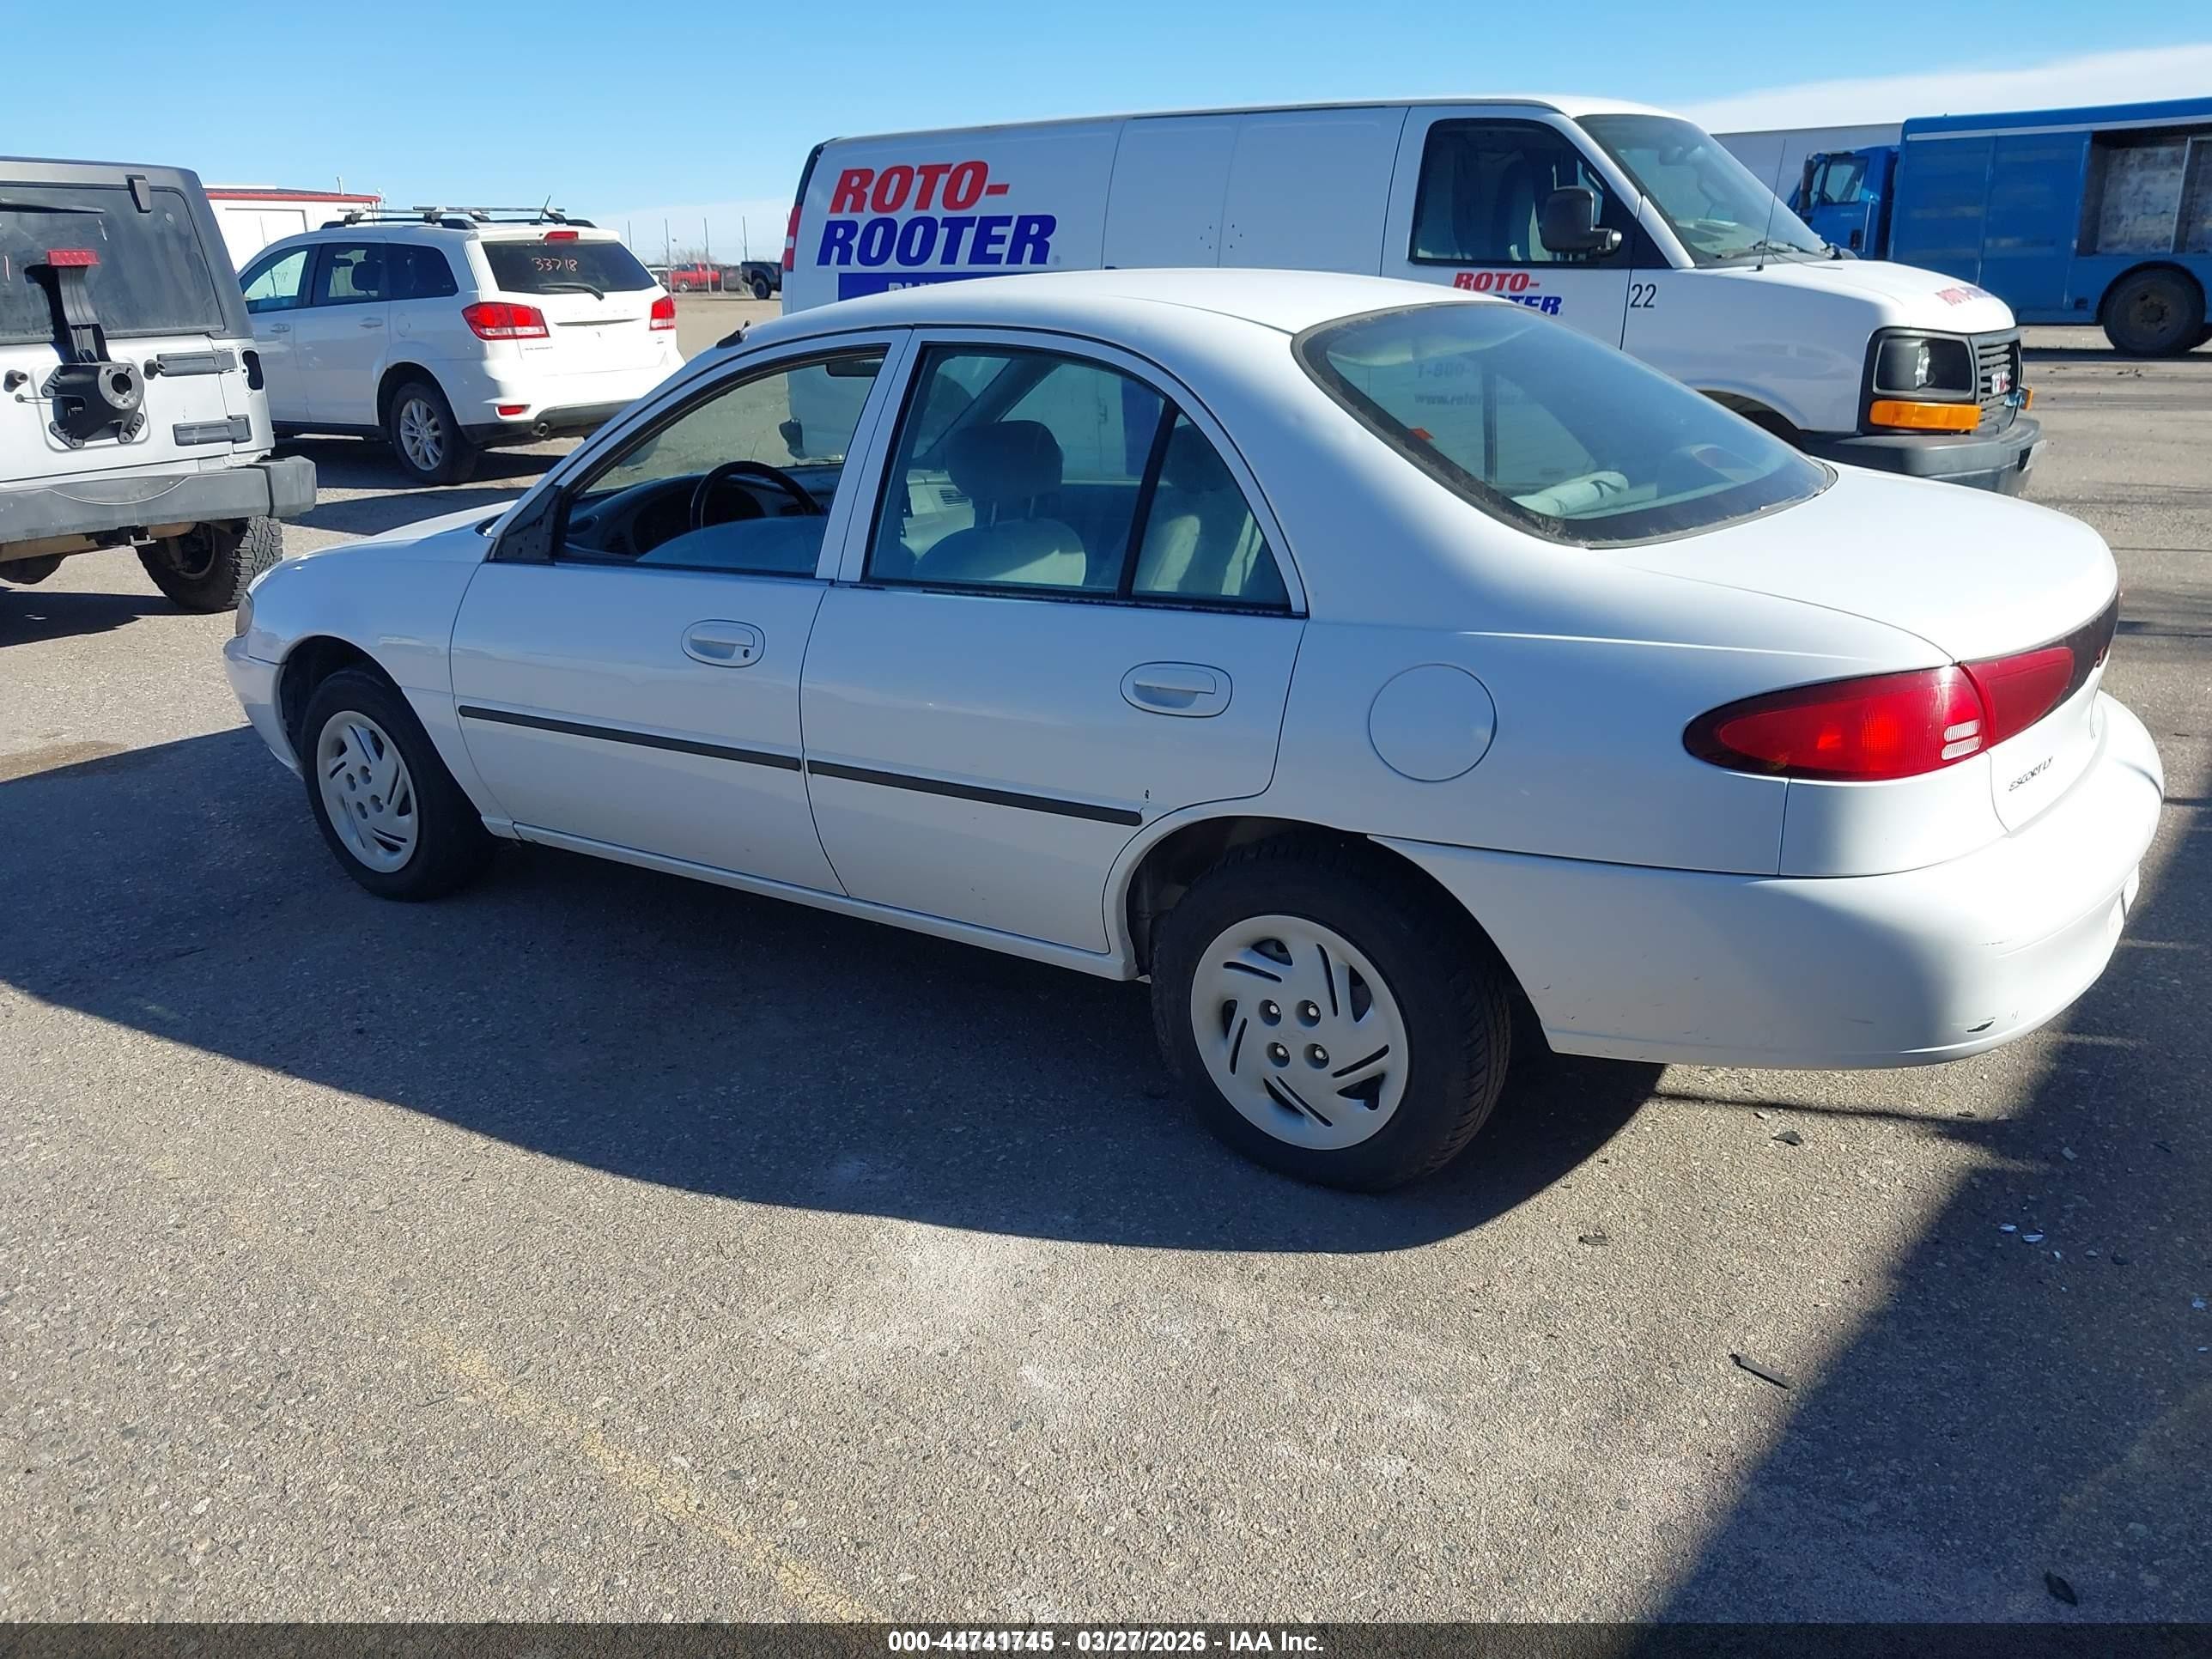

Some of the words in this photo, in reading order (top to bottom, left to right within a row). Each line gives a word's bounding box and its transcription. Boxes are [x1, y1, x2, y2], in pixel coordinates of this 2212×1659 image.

[830, 161, 1011, 214] ROTO-
[817, 214, 1057, 266] ROOTER
[1453, 272, 1540, 293] ROTO-
[1630, 283, 1657, 308] 22
